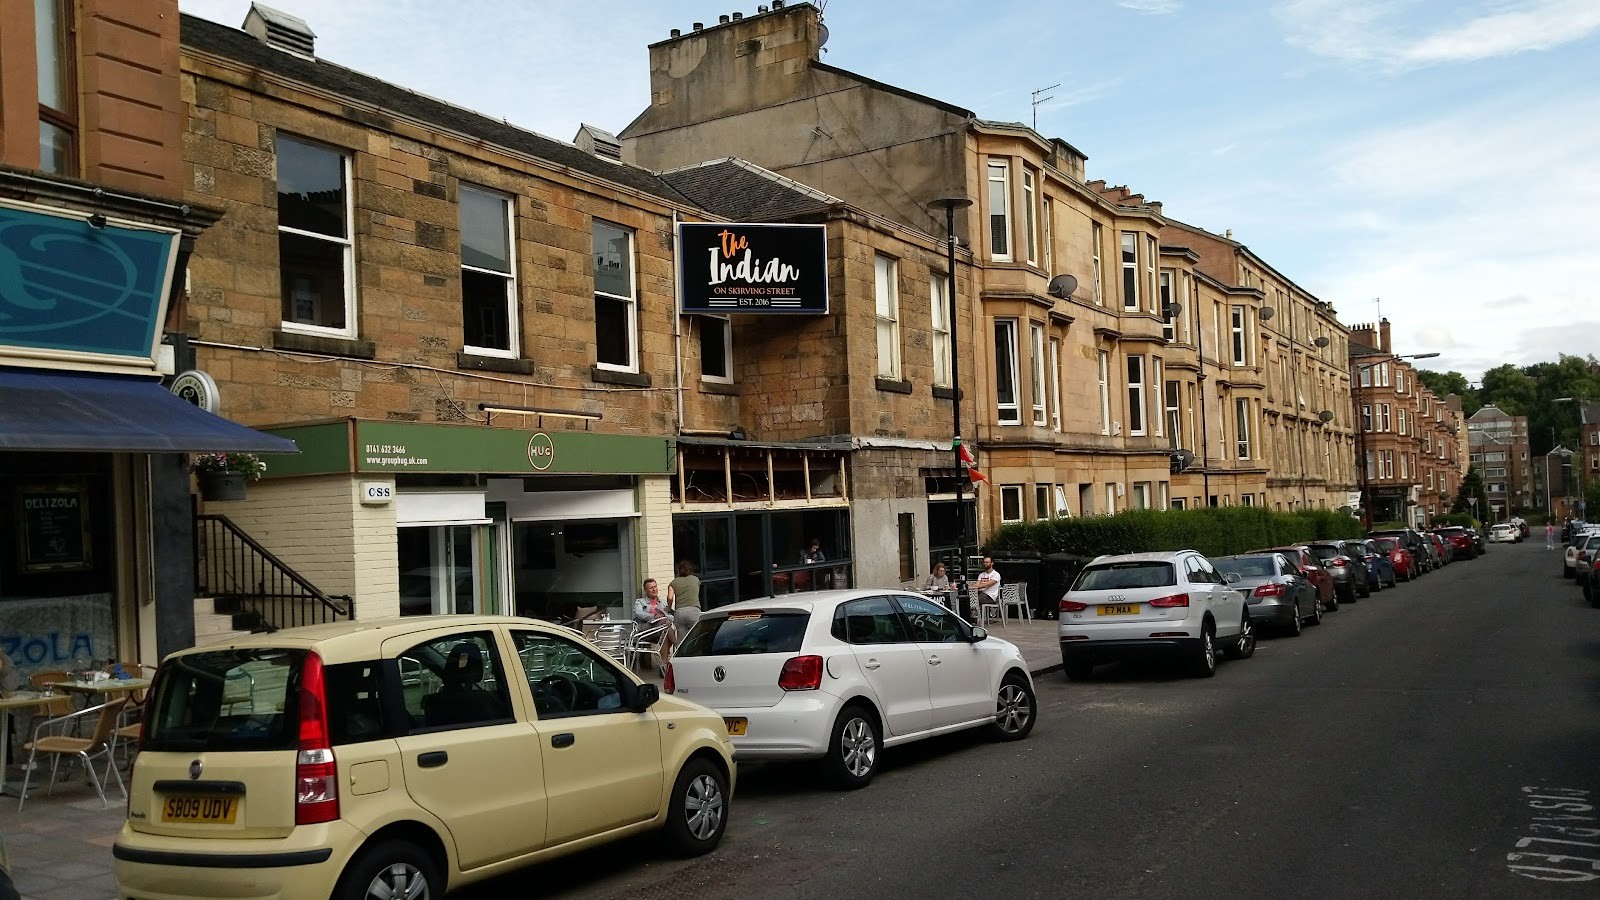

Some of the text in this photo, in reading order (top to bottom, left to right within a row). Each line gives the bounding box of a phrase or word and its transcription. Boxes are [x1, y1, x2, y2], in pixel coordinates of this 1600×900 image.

[717, 229, 749, 259] the
[708, 247, 800, 286] Indian
[713, 287, 796, 295] ON SKIRVING STREET
[739, 298, 770, 306] EST. 2016
[365, 444, 406, 454] 0141 632 3466
[530, 445, 551, 457] HUG
[365, 456, 428, 467] www.grouphug.uk.com
[24, 497, 78, 510] DELIZOLA
[1105, 606, 1114, 614] E7
[1, 631, 94, 666] ZOLA
[725, 720, 741, 733] VC
[167, 798, 232, 819] SB09 UDV
